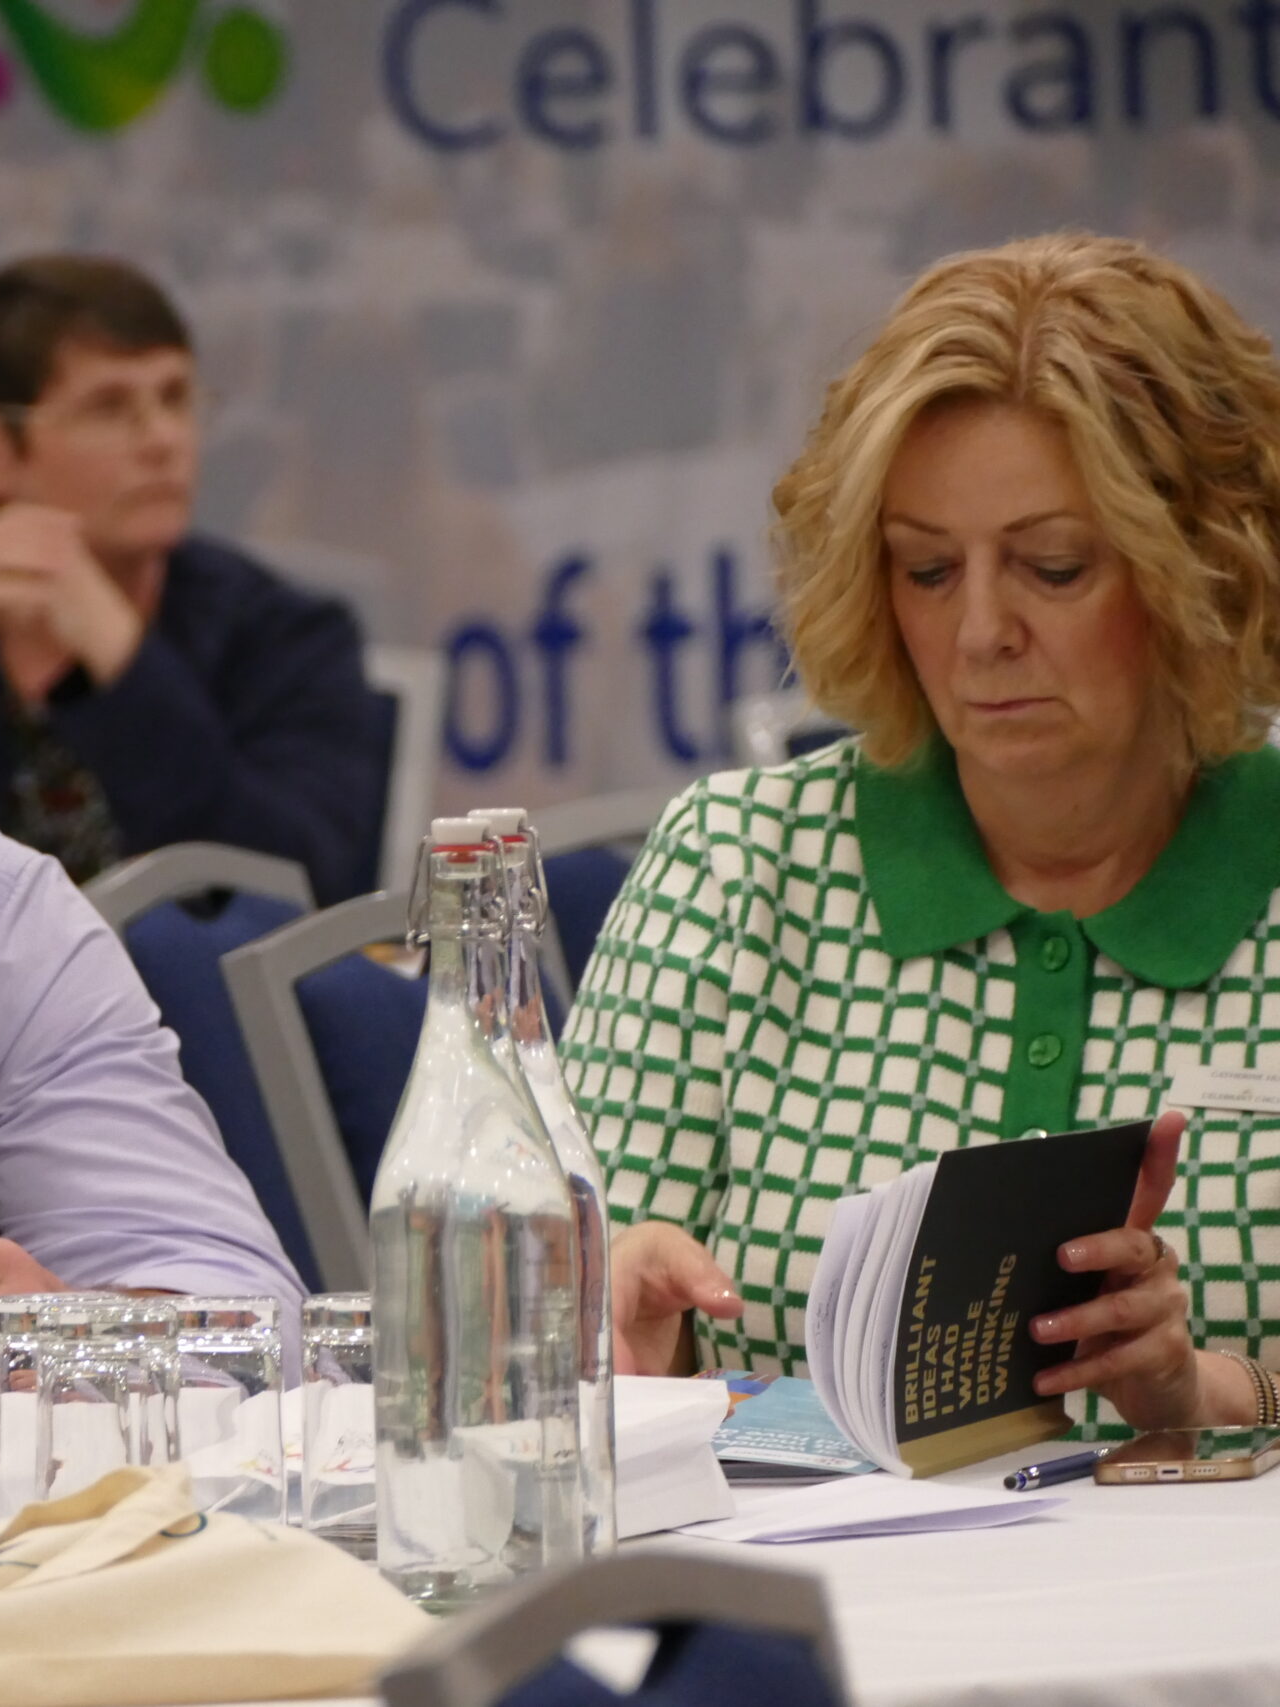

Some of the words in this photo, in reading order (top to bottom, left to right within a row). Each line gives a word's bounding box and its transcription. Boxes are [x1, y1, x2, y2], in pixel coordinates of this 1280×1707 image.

[380, 0, 1280, 152] Celebrant
[444, 550, 592, 771] of
[644, 546, 798, 765] th
[905, 1255, 936, 1424] BRILLIANT
[923, 1324, 941, 1420] IDEAS
[940, 1324, 960, 1393] HAD
[959, 1300, 984, 1410] WHILE
[977, 1254, 1017, 1405] DRINKING
[994, 1311, 1020, 1399] WINE
[941, 1405, 954, 1415] I
